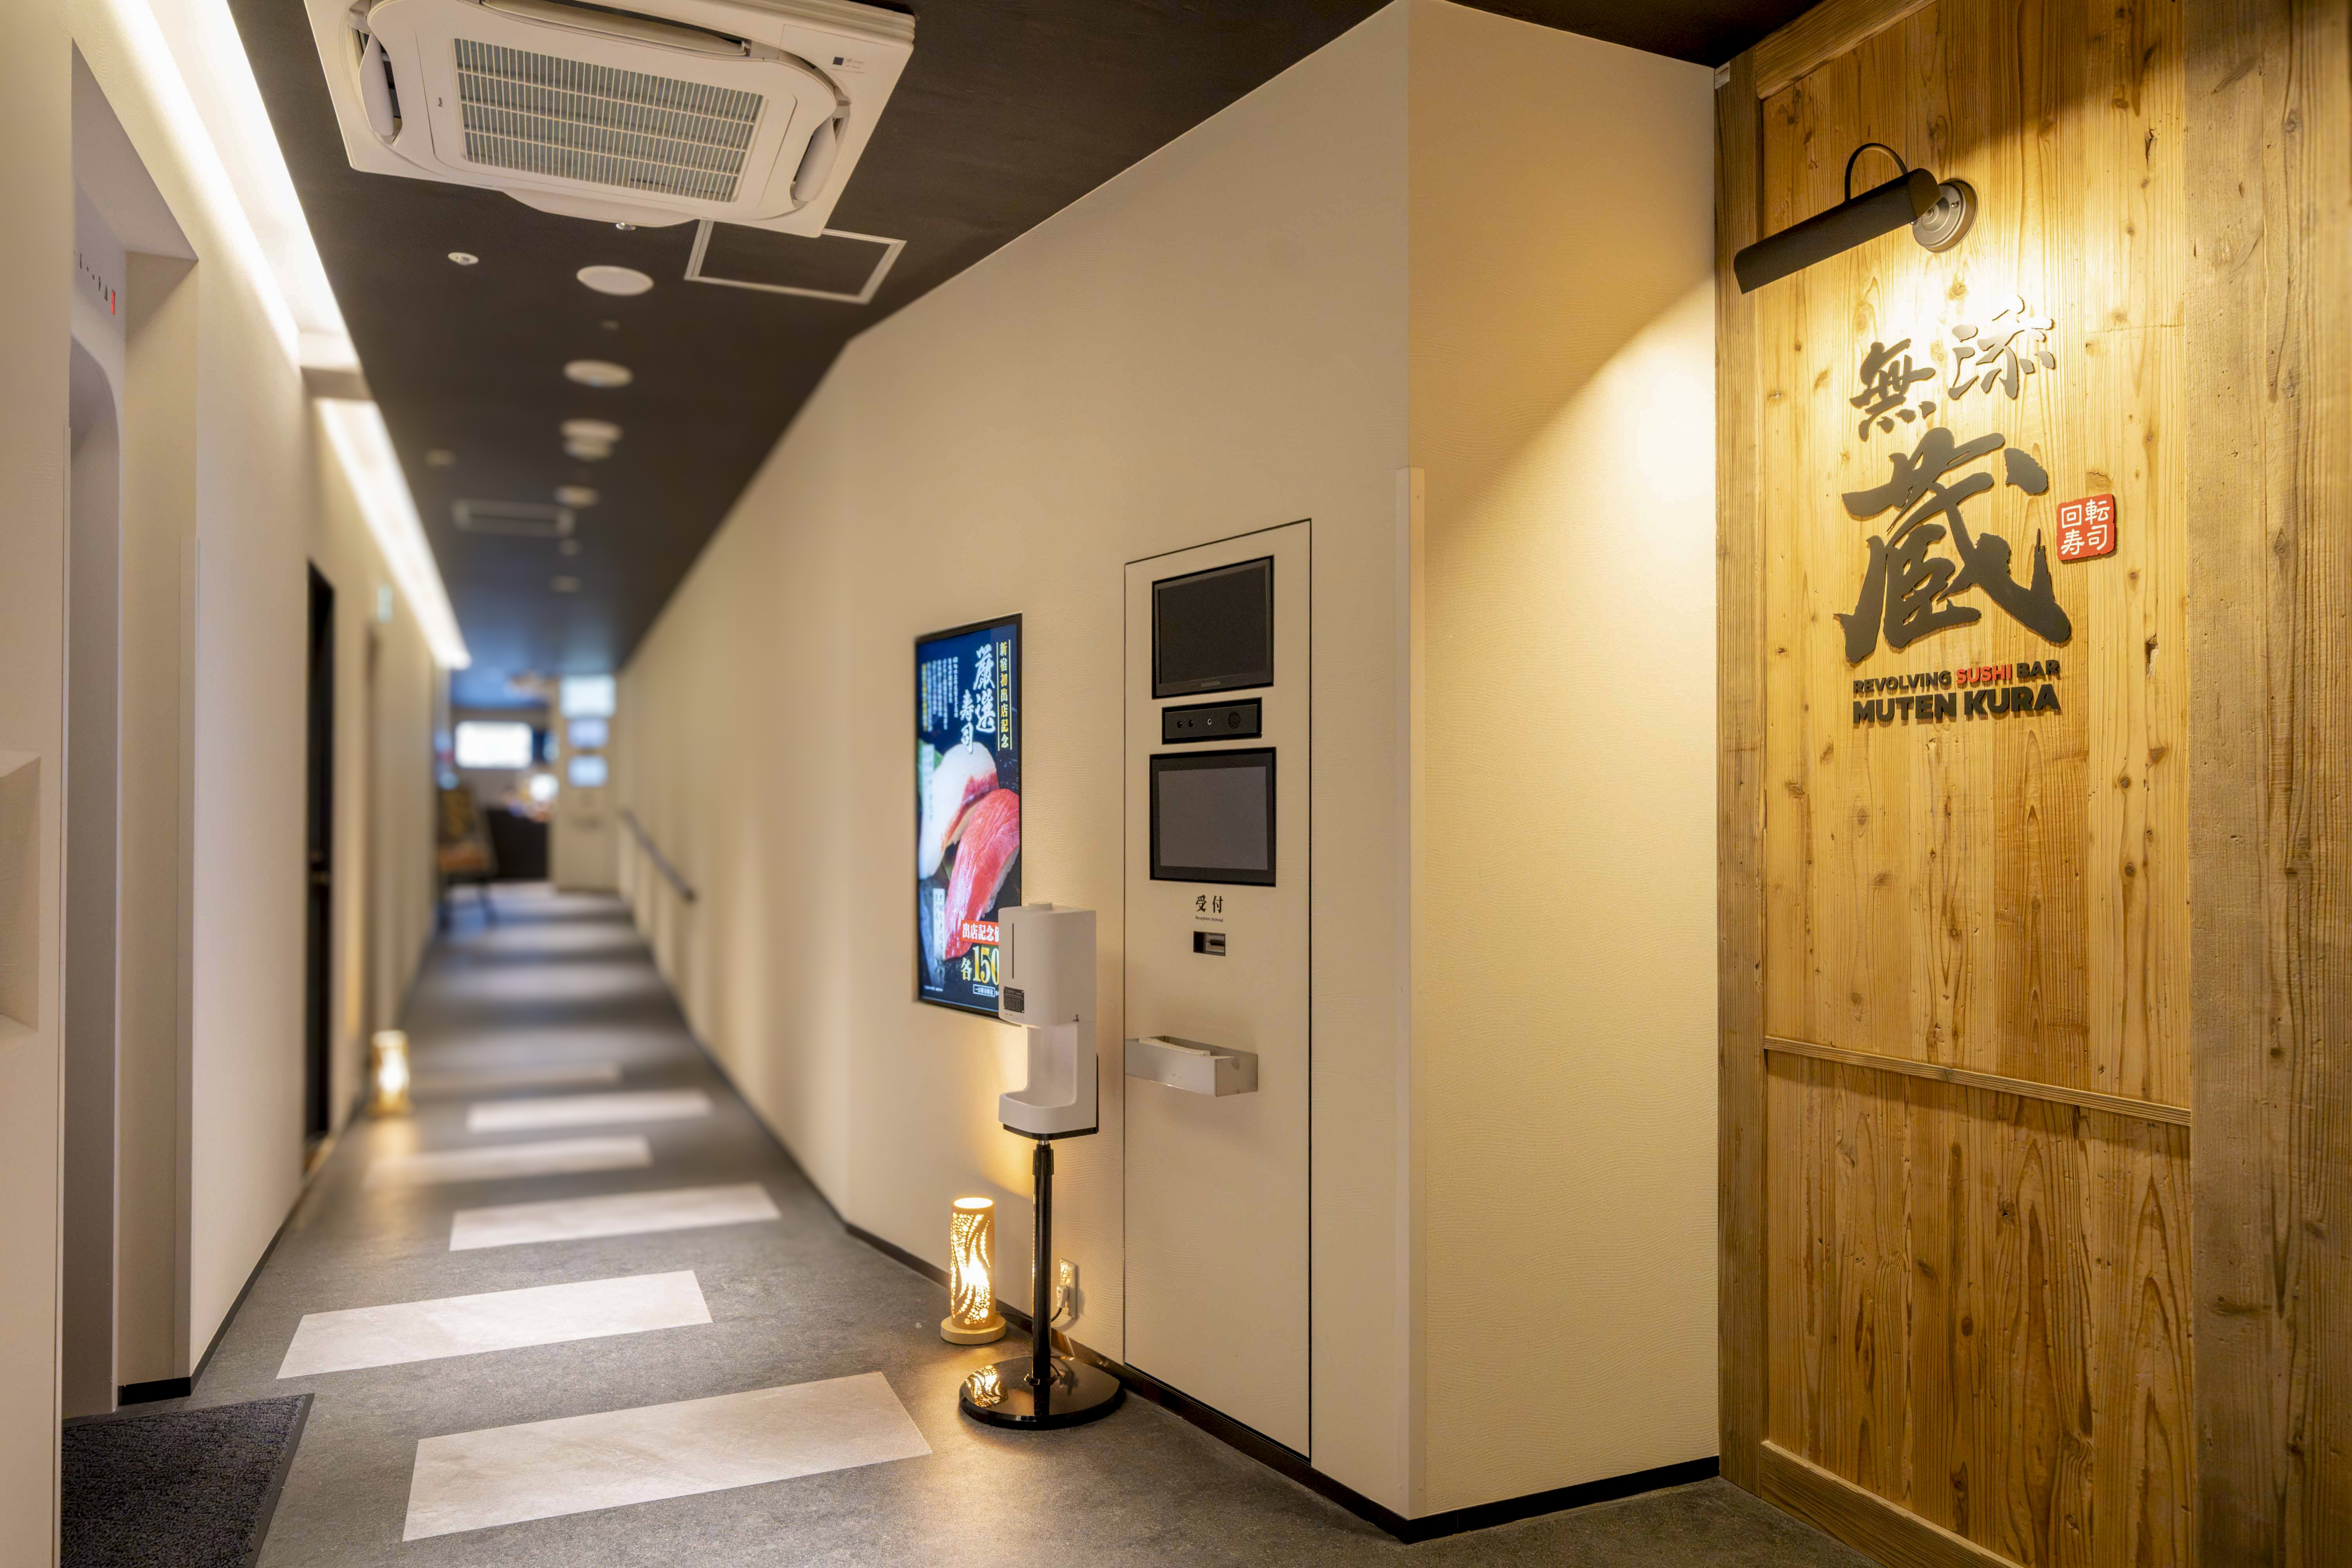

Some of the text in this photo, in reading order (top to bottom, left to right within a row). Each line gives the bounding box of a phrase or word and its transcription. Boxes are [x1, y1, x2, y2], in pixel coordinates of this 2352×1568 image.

[2061, 499, 2111, 529] 回転
[1834, 427, 2071, 663] 蔵
[2060, 524, 2107, 555] 寿司
[1853, 659, 2060, 694] REVOLVING SUSHI BAR
[1853, 684, 2061, 724] MUTEN KURA
[1195, 894, 1224, 914] 受付
